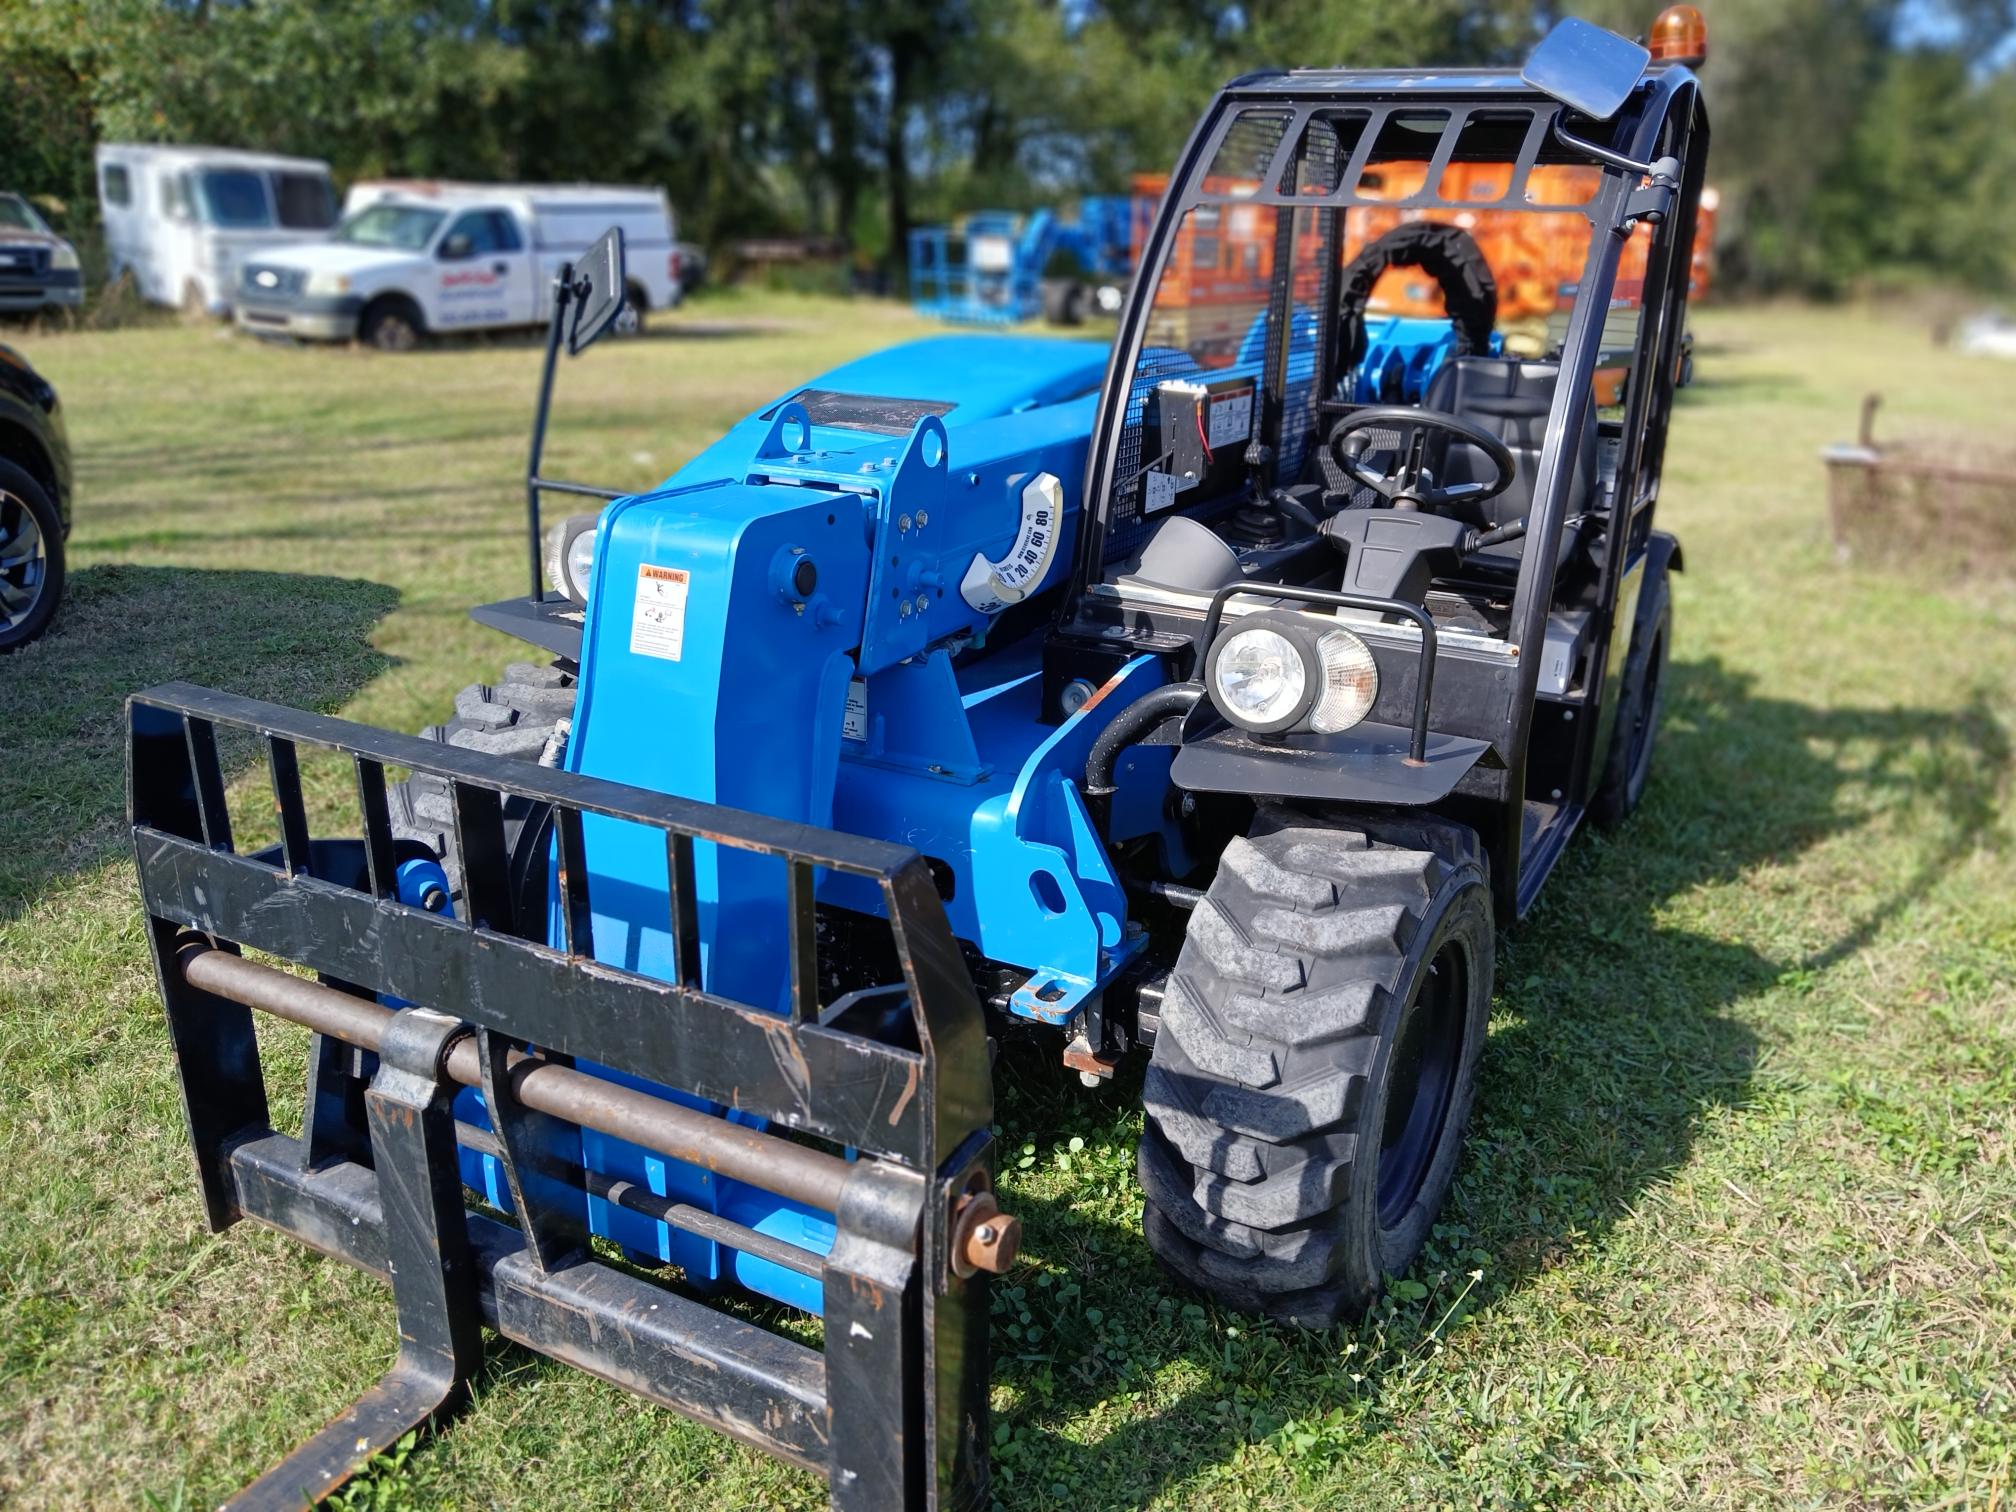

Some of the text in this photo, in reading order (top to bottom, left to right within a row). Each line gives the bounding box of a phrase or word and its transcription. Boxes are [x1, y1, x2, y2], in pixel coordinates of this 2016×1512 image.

[1035, 510, 1048, 526] 80
[1031, 531, 1044, 547] 60
[1024, 550, 1038, 565] 40
[652, 569, 684, 583] WARNING
[1006, 572, 1016, 583] 0
[1015, 564, 1028, 578] 20
